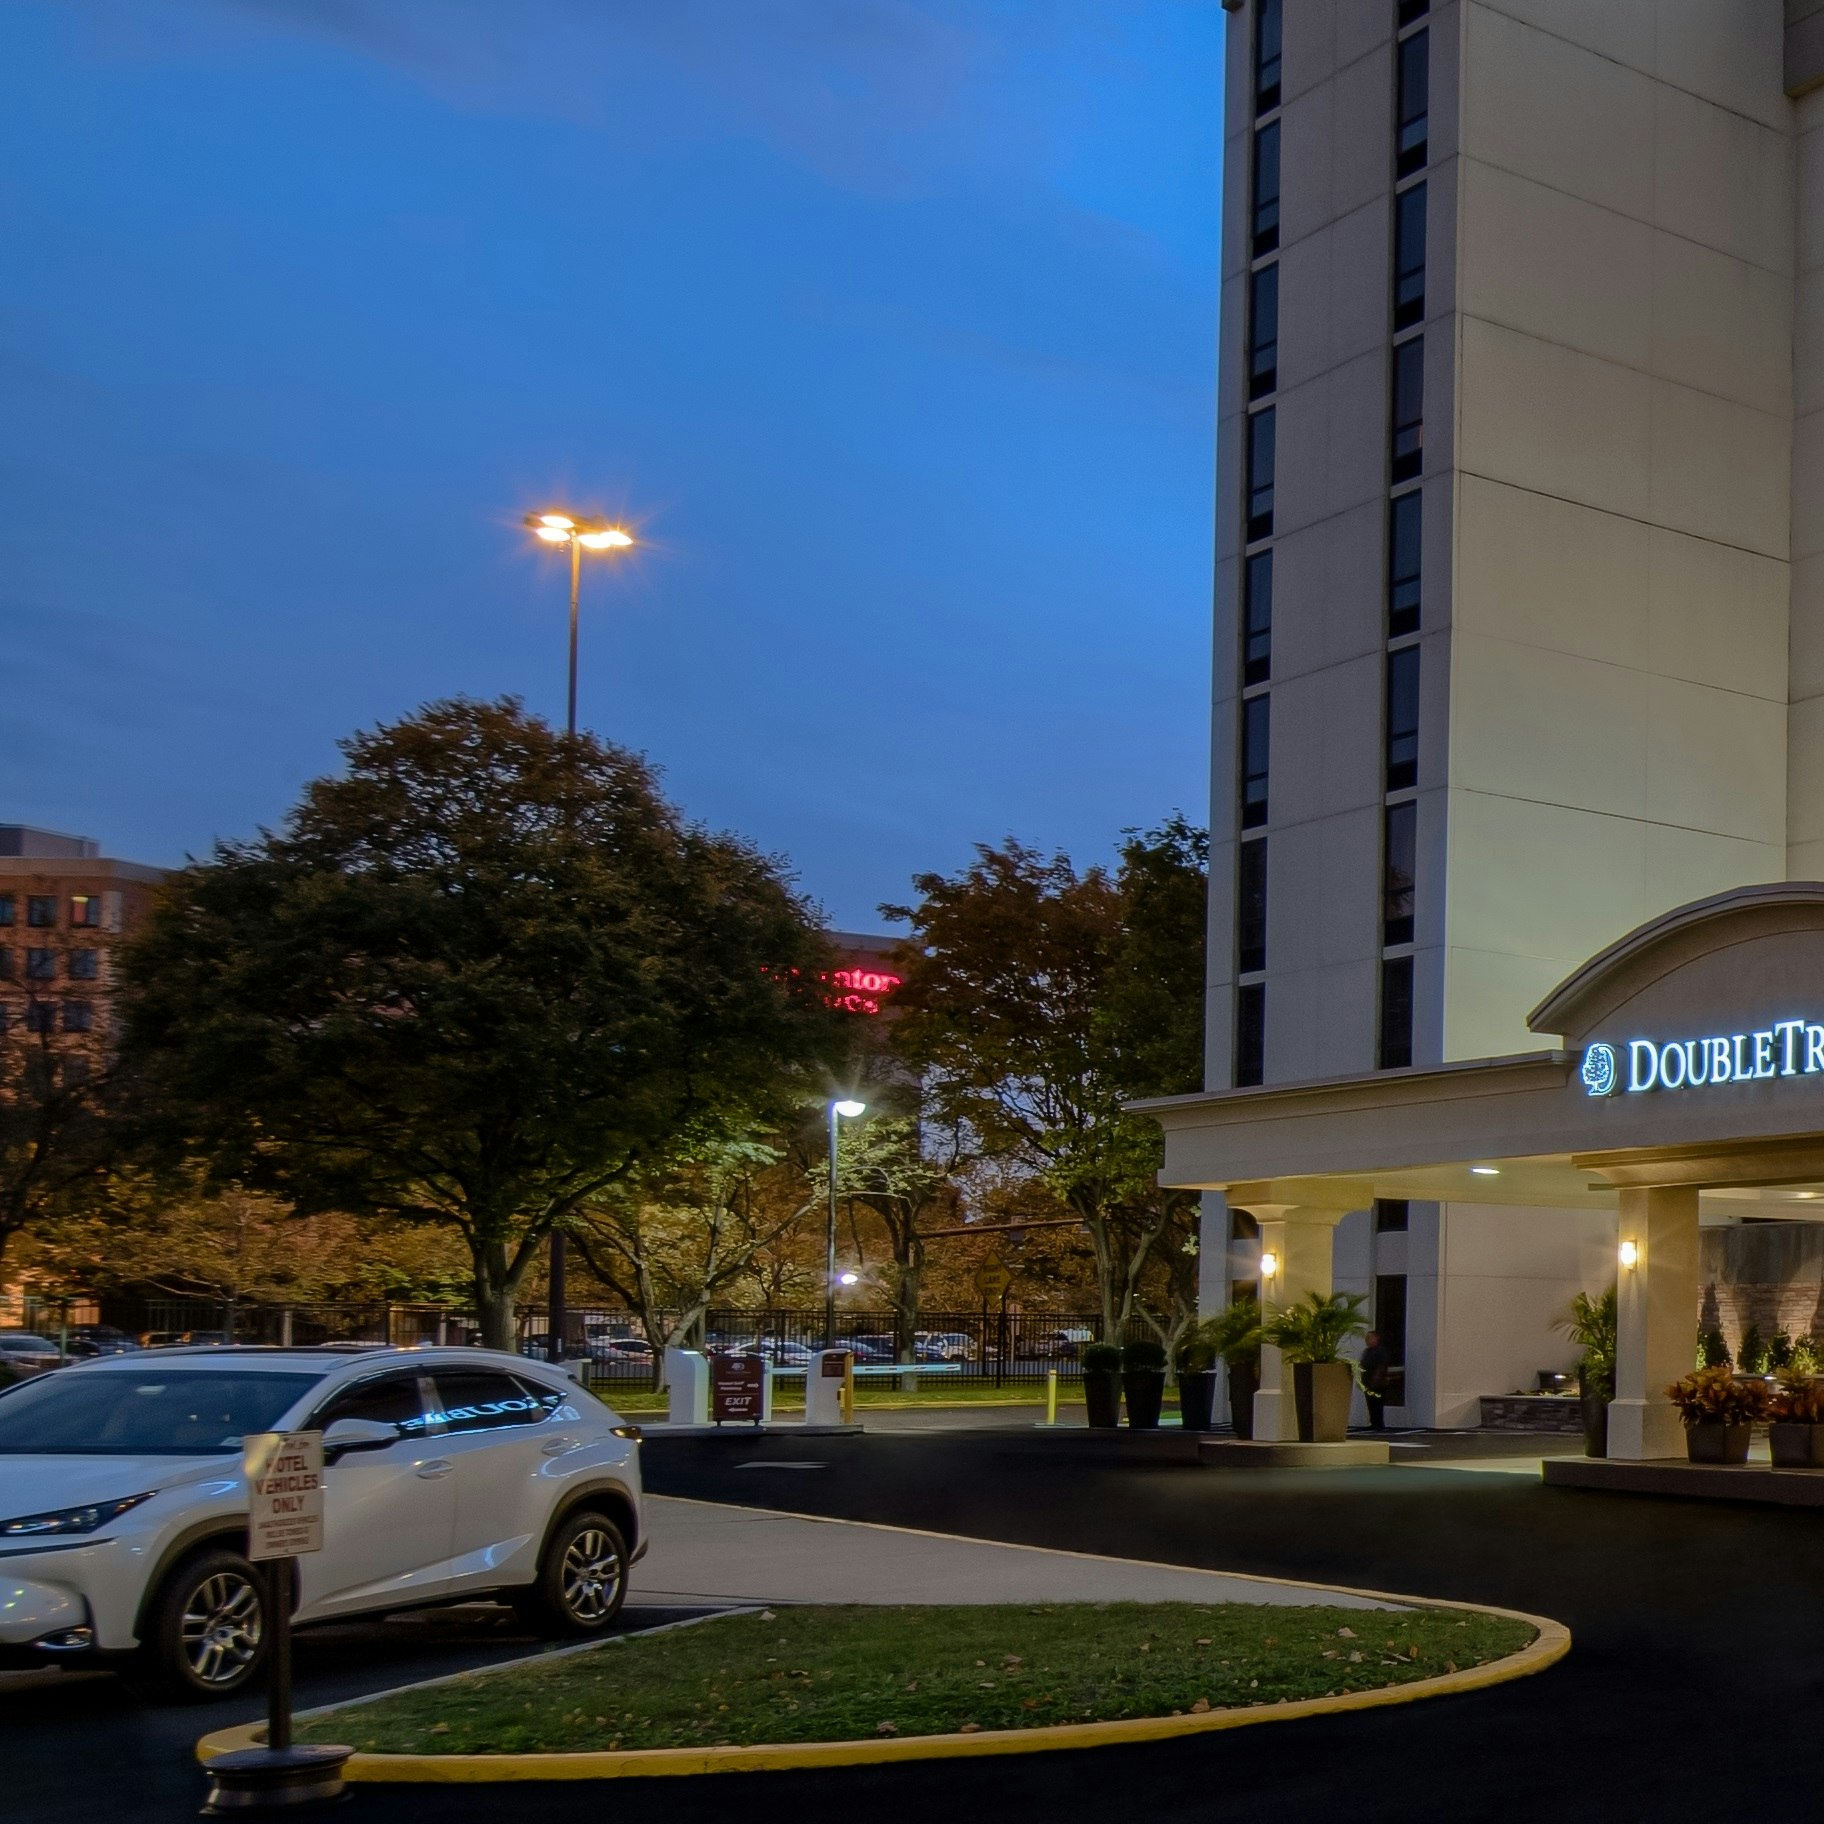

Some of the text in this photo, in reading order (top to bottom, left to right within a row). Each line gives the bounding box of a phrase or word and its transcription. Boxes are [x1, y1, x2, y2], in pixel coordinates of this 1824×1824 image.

[724, 1396, 752, 1406] EXIT
[255, 1474, 319, 1495] VEHICLES
[272, 1495, 305, 1514] ONLY
